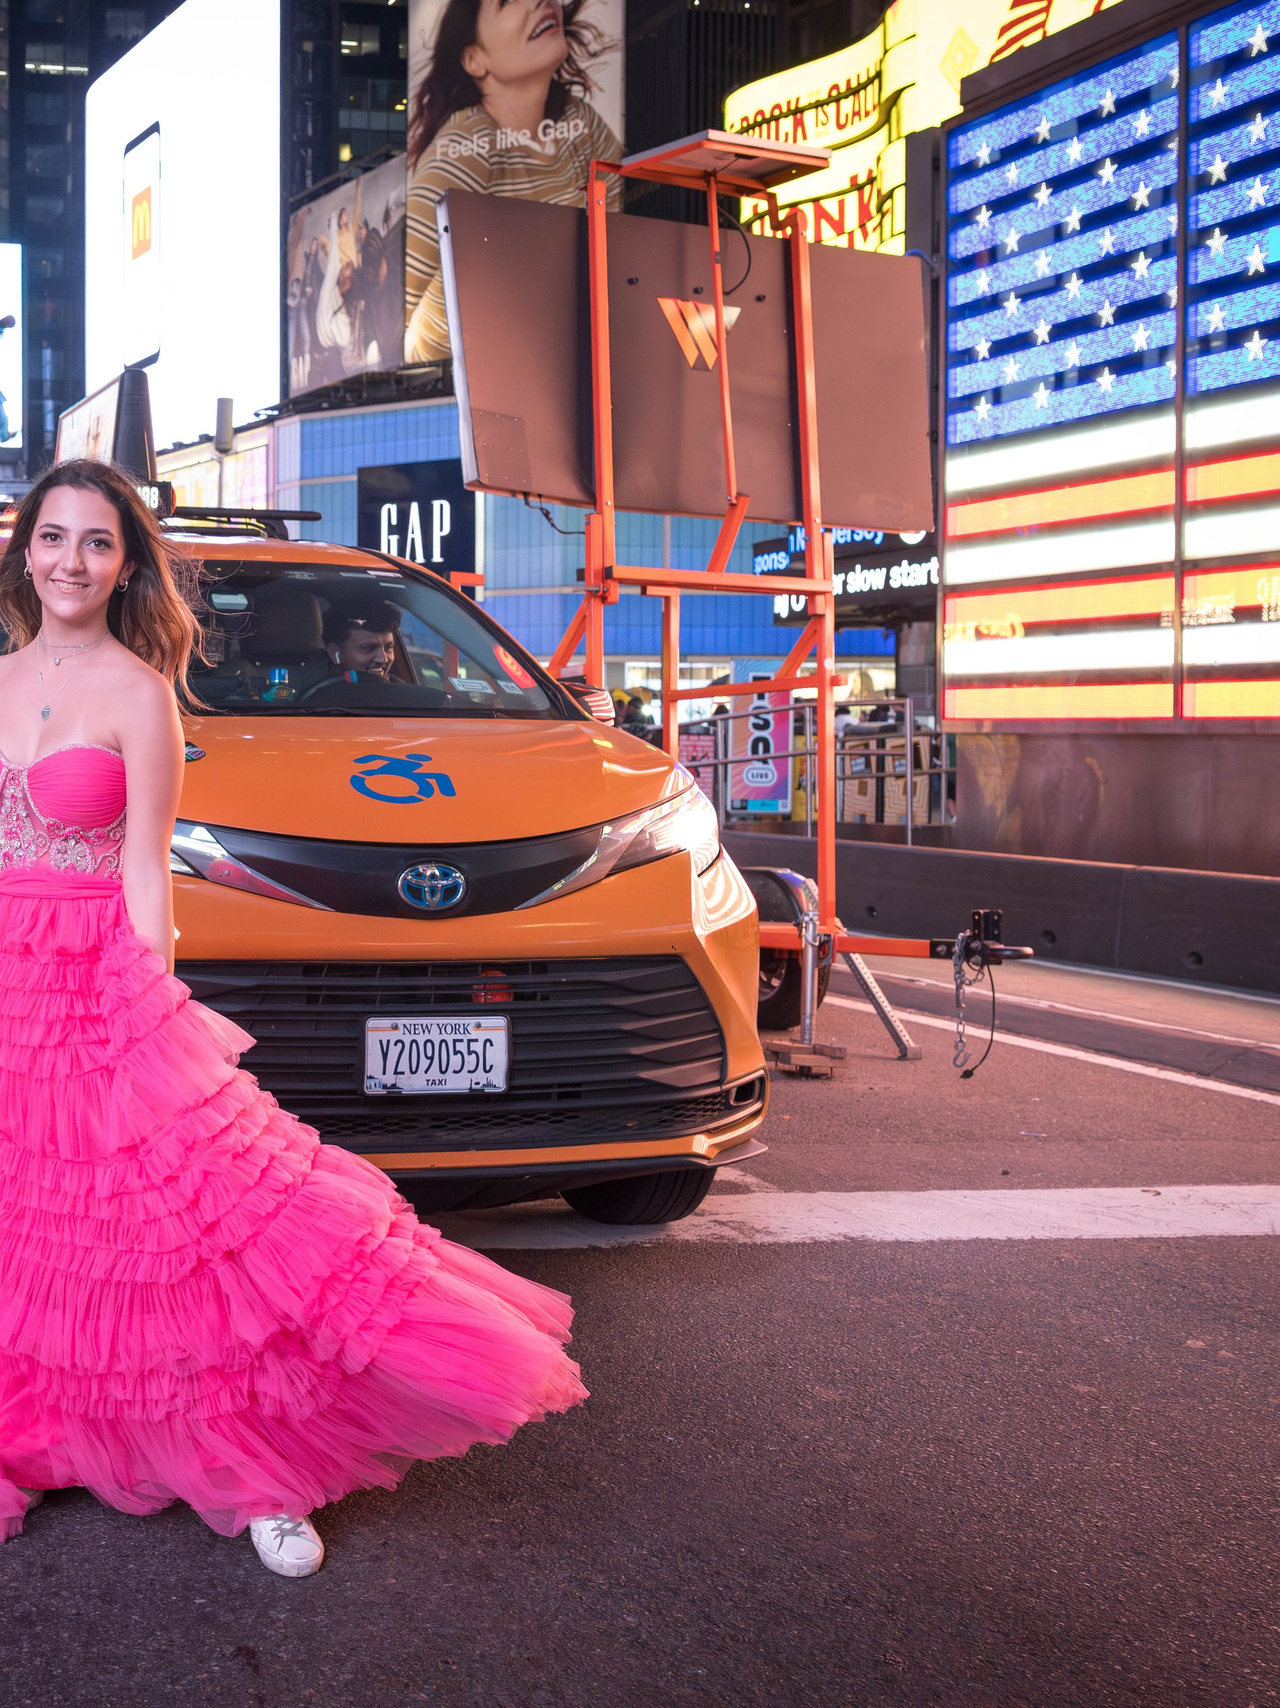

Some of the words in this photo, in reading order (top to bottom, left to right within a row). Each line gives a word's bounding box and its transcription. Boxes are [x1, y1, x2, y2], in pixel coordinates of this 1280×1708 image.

[436, 134, 490, 161] Feels
[496, 127, 531, 150] like
[538, 118, 589, 142] Gap.
[381, 499, 451, 563] GAP
[846, 563, 886, 594] slow
[889, 556, 940, 589] start
[751, 771, 769, 780] LIVE
[402, 1023, 433, 1035] NEW
[435, 1022, 472, 1036] YORK
[378, 1037, 494, 1076] Y209055C
[425, 1078, 447, 1087] TAXI
